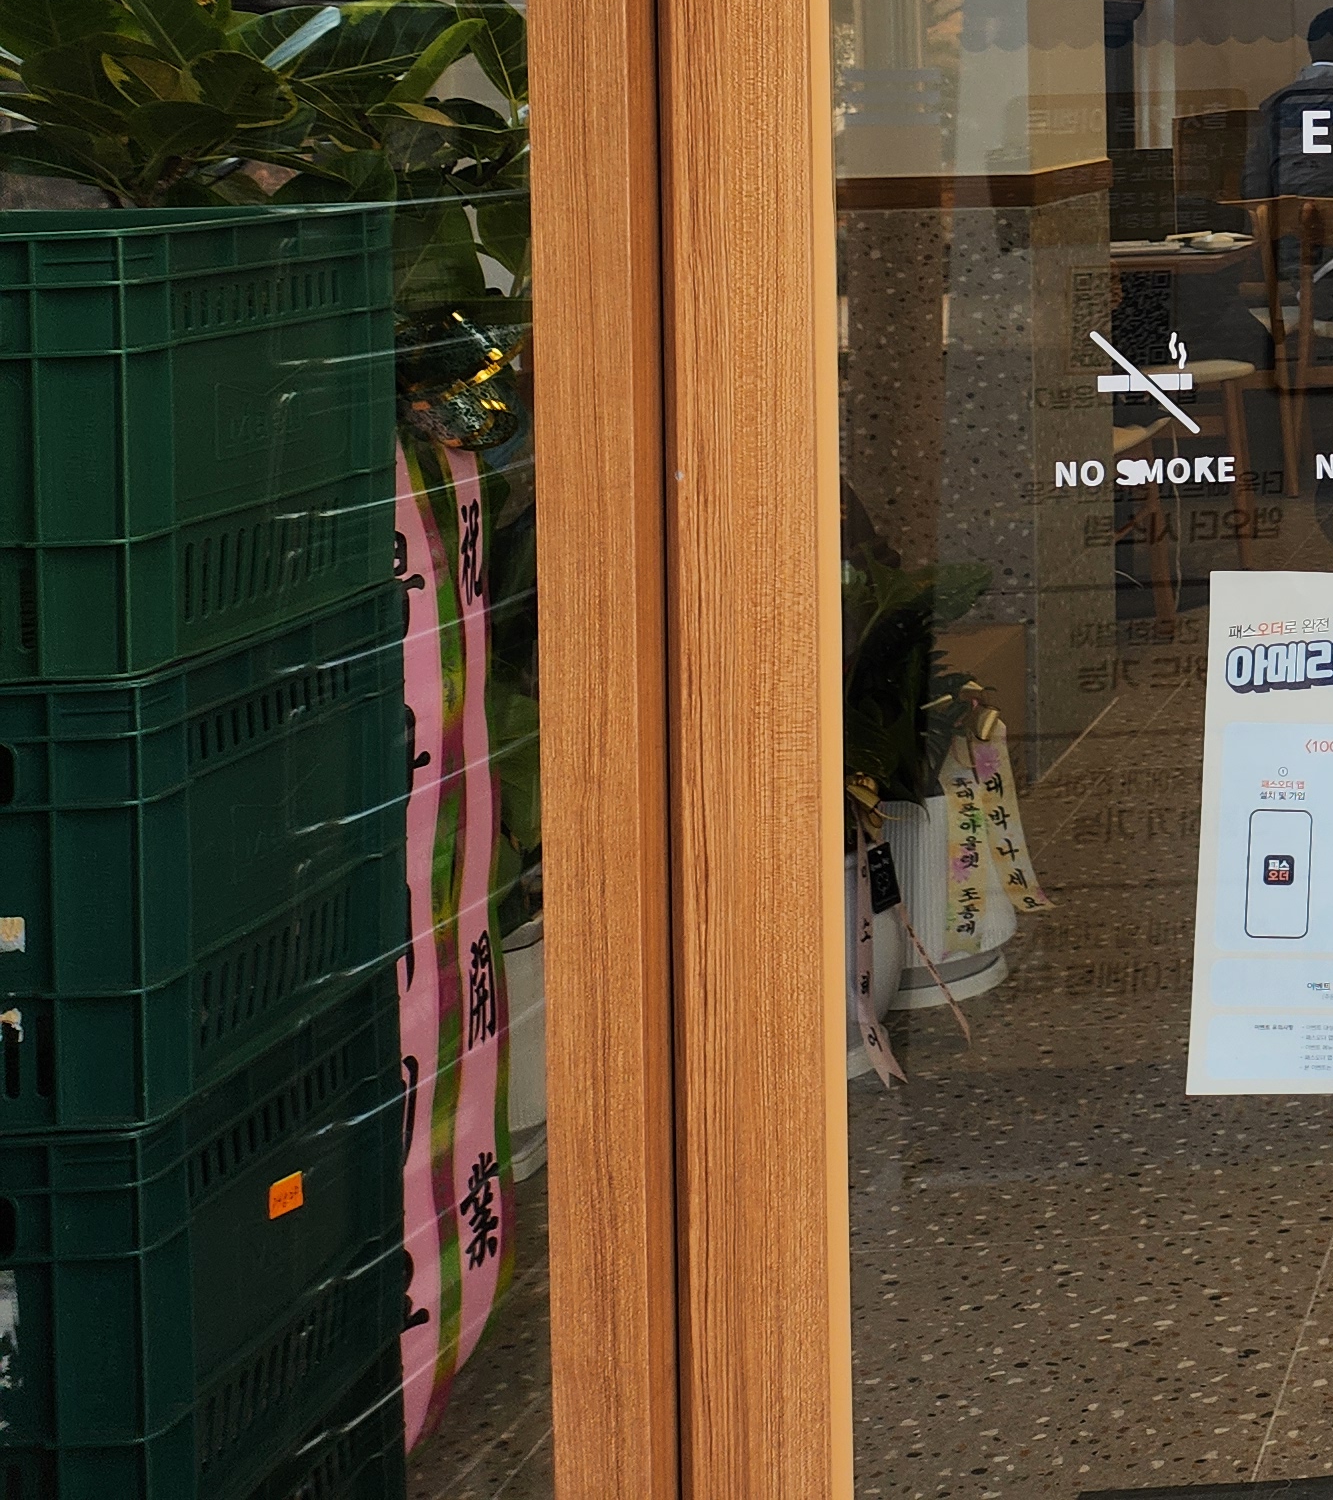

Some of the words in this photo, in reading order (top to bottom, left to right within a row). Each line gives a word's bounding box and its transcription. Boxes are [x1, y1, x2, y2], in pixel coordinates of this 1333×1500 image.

[1055, 460, 1104, 488] NO
[1228, 619, 1297, 639] 패스오더로
[1302, 618, 1330, 635] 완전
